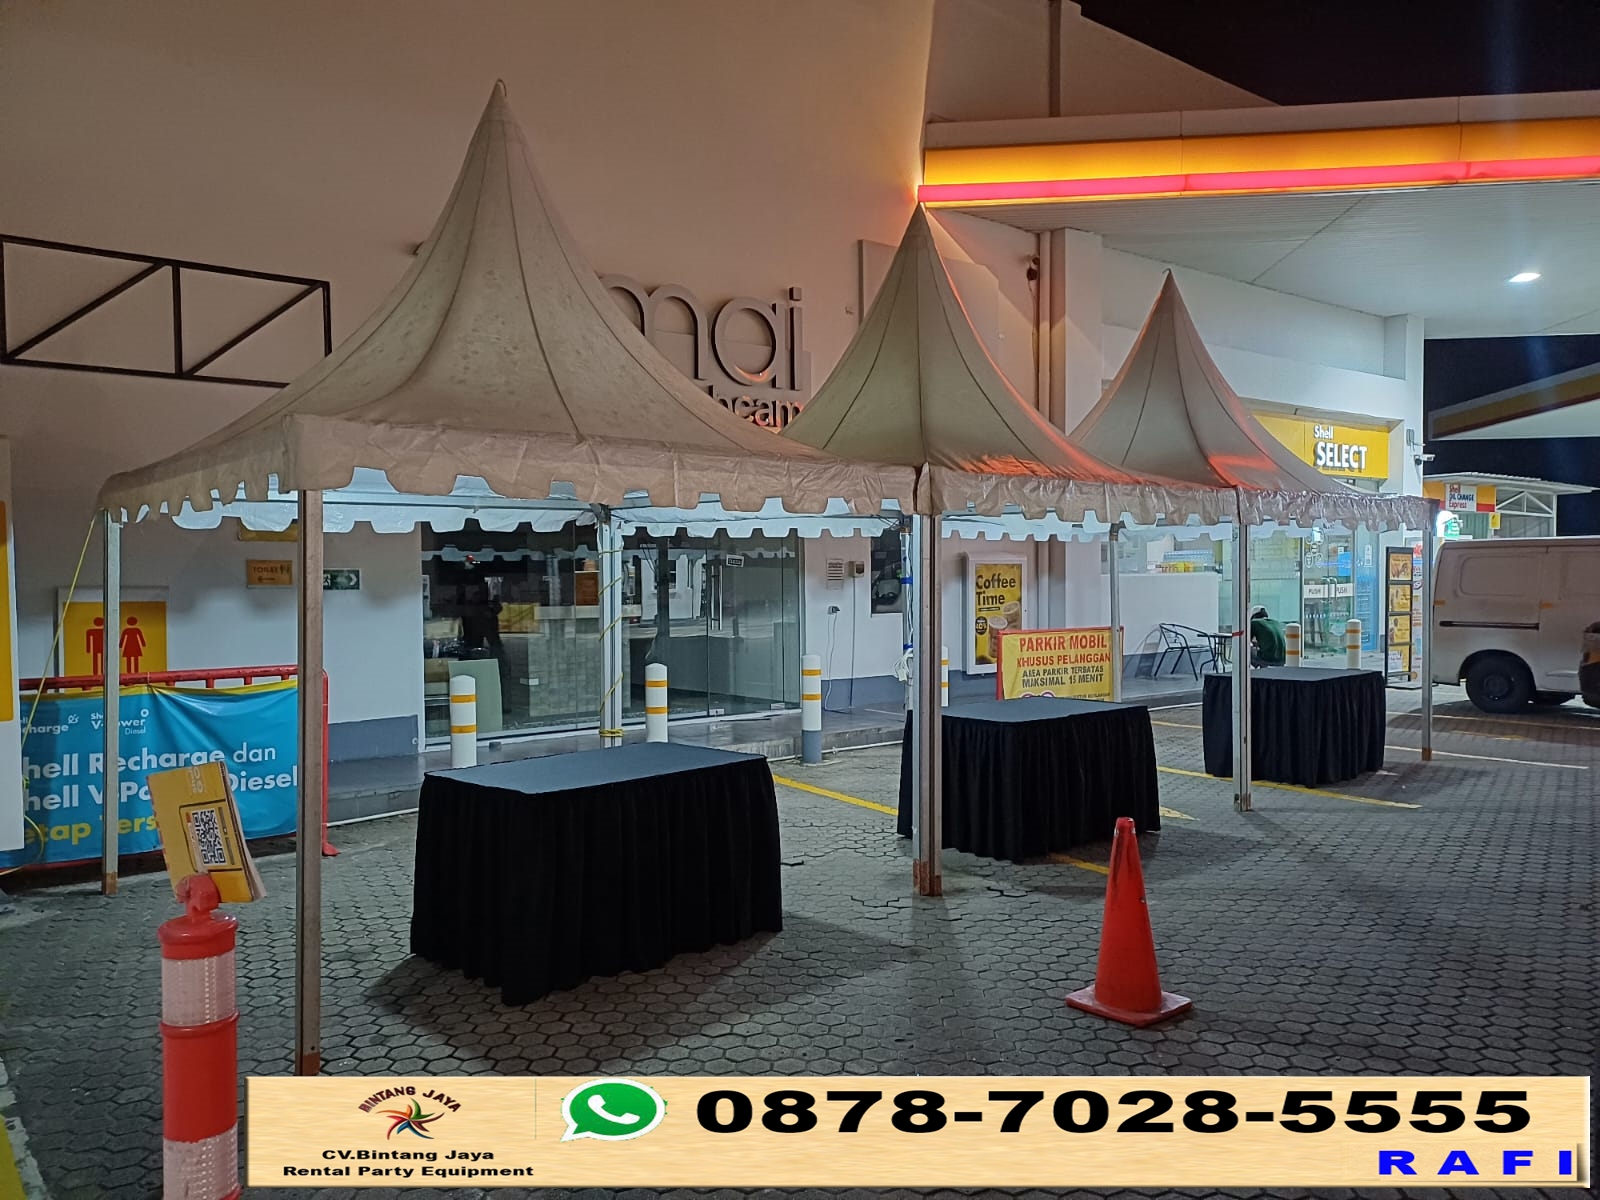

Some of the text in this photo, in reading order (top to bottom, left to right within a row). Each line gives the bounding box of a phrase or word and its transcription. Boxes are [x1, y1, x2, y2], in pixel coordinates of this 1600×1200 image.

[1314, 424, 1334, 440] Shell
[1315, 441, 1368, 470] SELECT
[976, 573, 1016, 589] Coffee
[976, 590, 1005, 605] Time
[1019, 634, 1107, 652] PARKIR MOBIL
[1017, 652, 1111, 668] KHUSUS PELANGGAN
[1042, 667, 1069, 676] PARKIR
[1078, 673, 1104, 683] MENIT
[232, 741, 277, 763] dan
